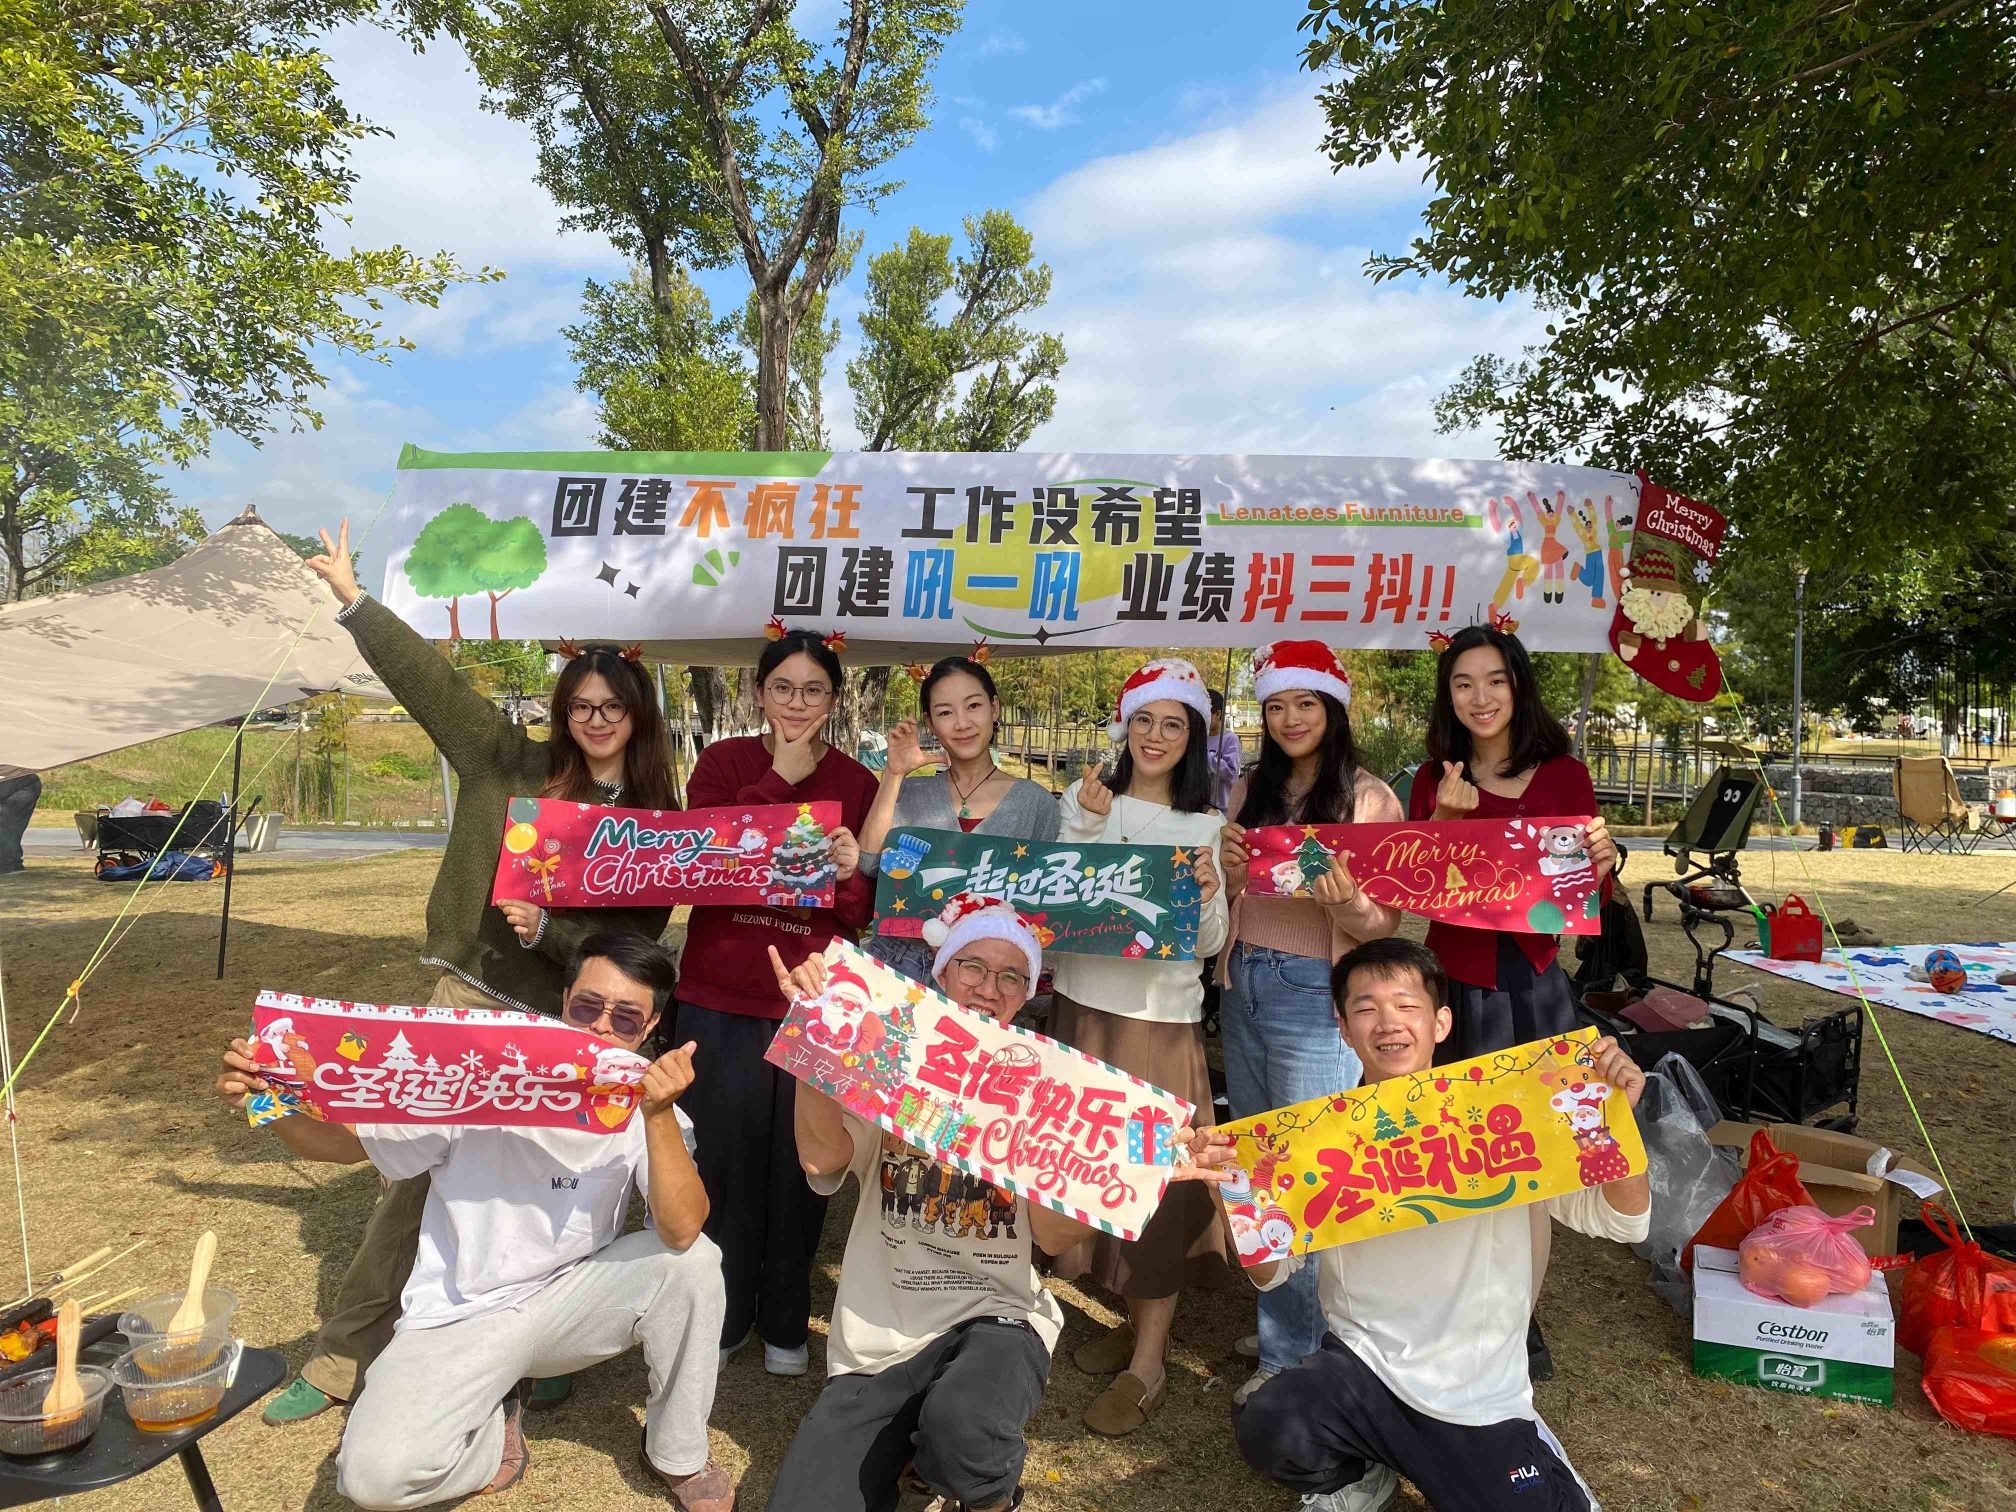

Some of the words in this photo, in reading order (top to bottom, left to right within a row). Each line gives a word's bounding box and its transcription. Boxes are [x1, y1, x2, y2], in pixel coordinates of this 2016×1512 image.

[551, 477, 863, 539] 团建不疯狂
[901, 487, 1202, 547] 工作没希望
[1219, 503, 1339, 521] Lenatees
[1345, 503, 1465, 523] Furniture
[1646, 509, 1715, 558] Christmas
[1665, 493, 1713, 531] Merry
[774, 546, 1081, 621] 团建吼一吼
[584, 816, 745, 865] Merry
[1372, 830, 1481, 872] Merry
[584, 851, 773, 895] Christmas
[920, 849, 1168, 926] 一起过圣诞
[1050, 920, 1135, 941] Christmas
[313, 1062, 581, 1117] 圣诞快乐
[917, 1016, 1127, 1153] 圣诞快乐
[980, 1118, 1137, 1209] Christmas
[1304, 1104, 1542, 1228] 圣诞礼遇
[1756, 1335, 1779, 1344] Purified
[1780, 1339, 1803, 1349] Drinking
[1805, 1341, 1824, 1350] Water
[1509, 1464, 1540, 1483] FILA
